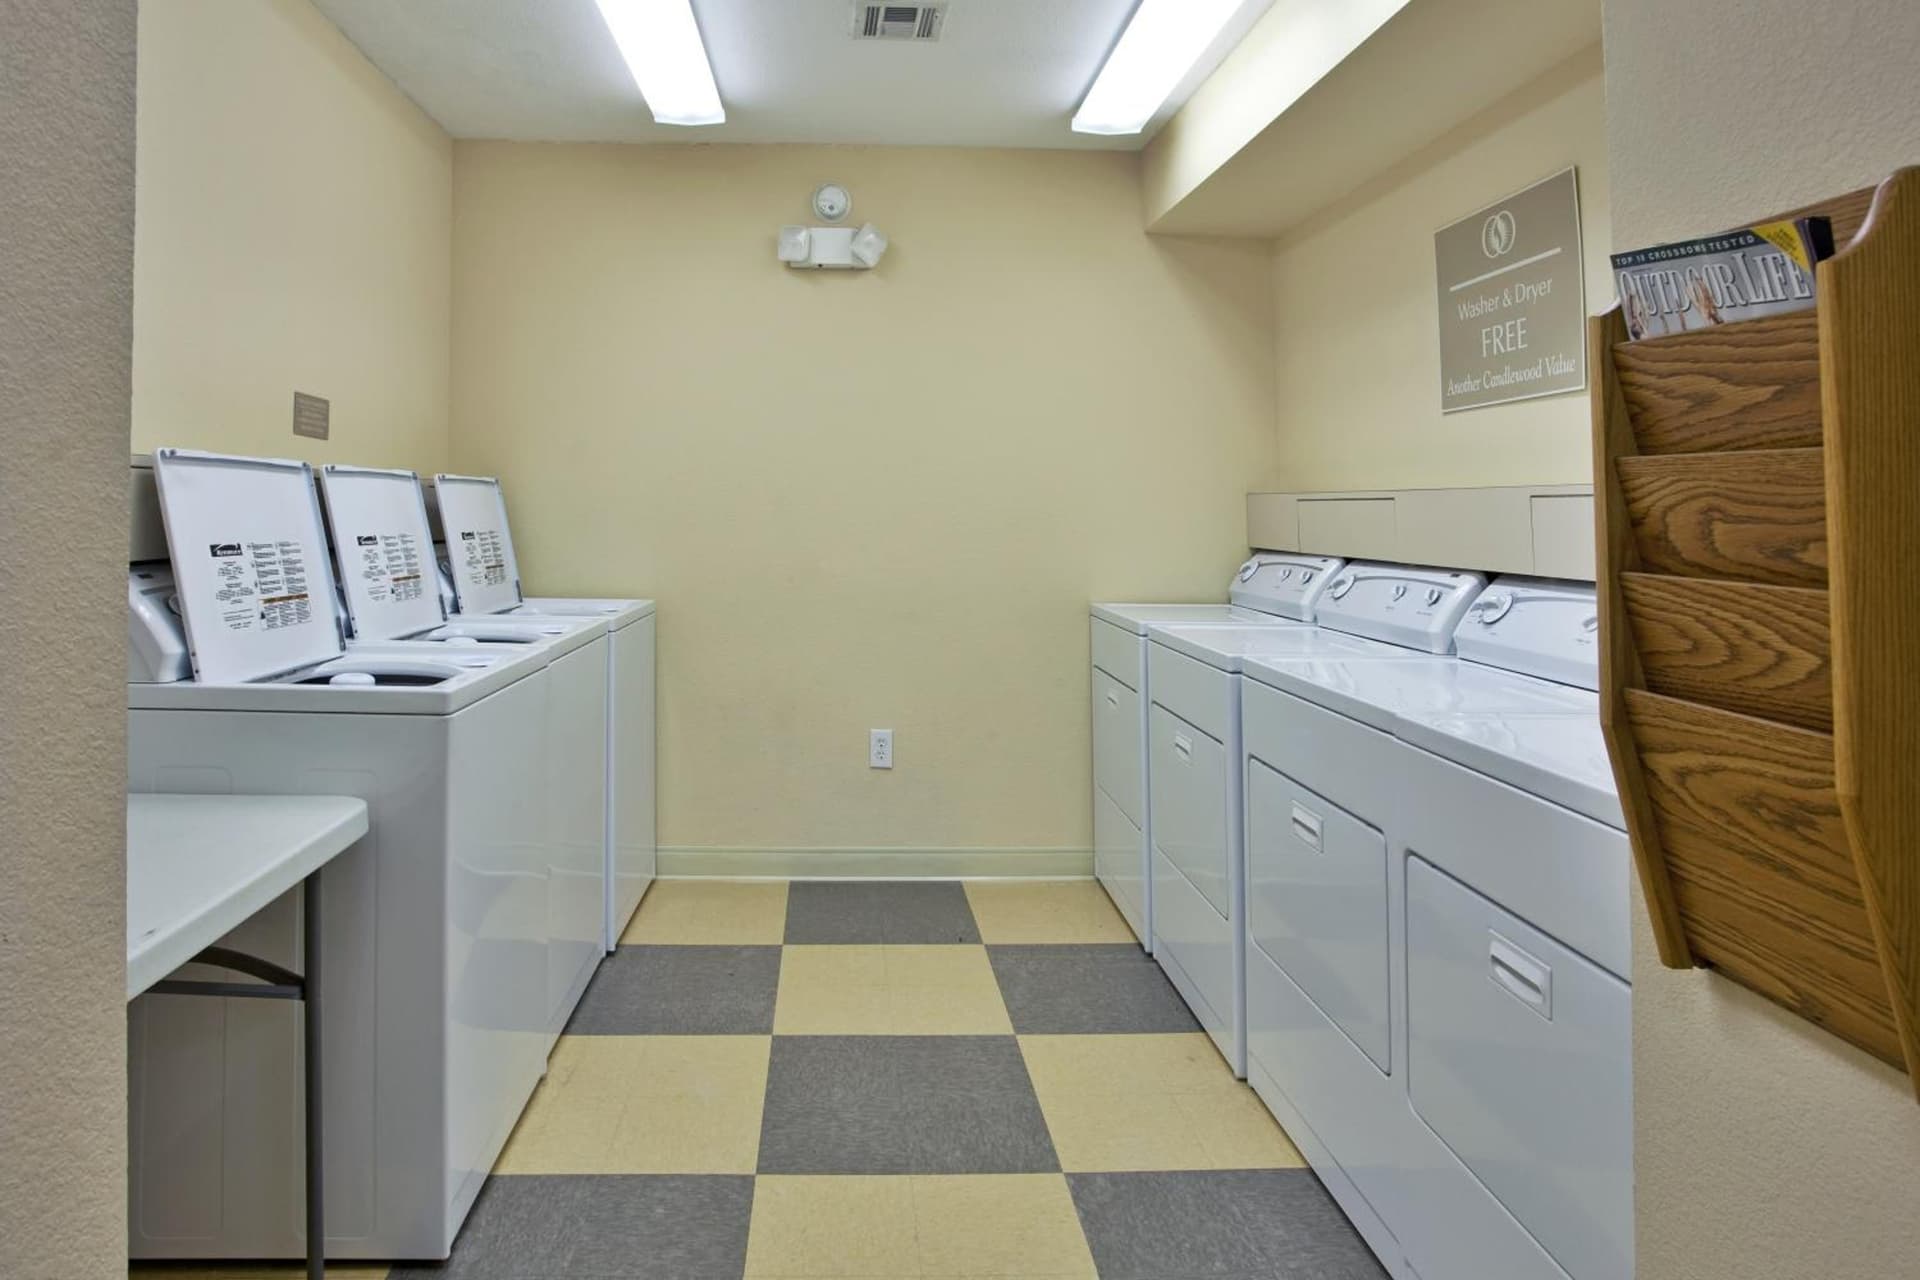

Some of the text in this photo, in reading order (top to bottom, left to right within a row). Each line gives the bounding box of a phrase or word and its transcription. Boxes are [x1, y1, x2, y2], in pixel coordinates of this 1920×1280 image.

[1615, 256, 1633, 266] TOP
[1708, 235, 1755, 251] TESTED
[1457, 277, 1552, 321] Washer & Dryer
[1619, 252, 1812, 320] OUTDOOR LIFE
[1481, 317, 1528, 358] FREE
[1447, 353, 1576, 396] Another Candlewood Value
